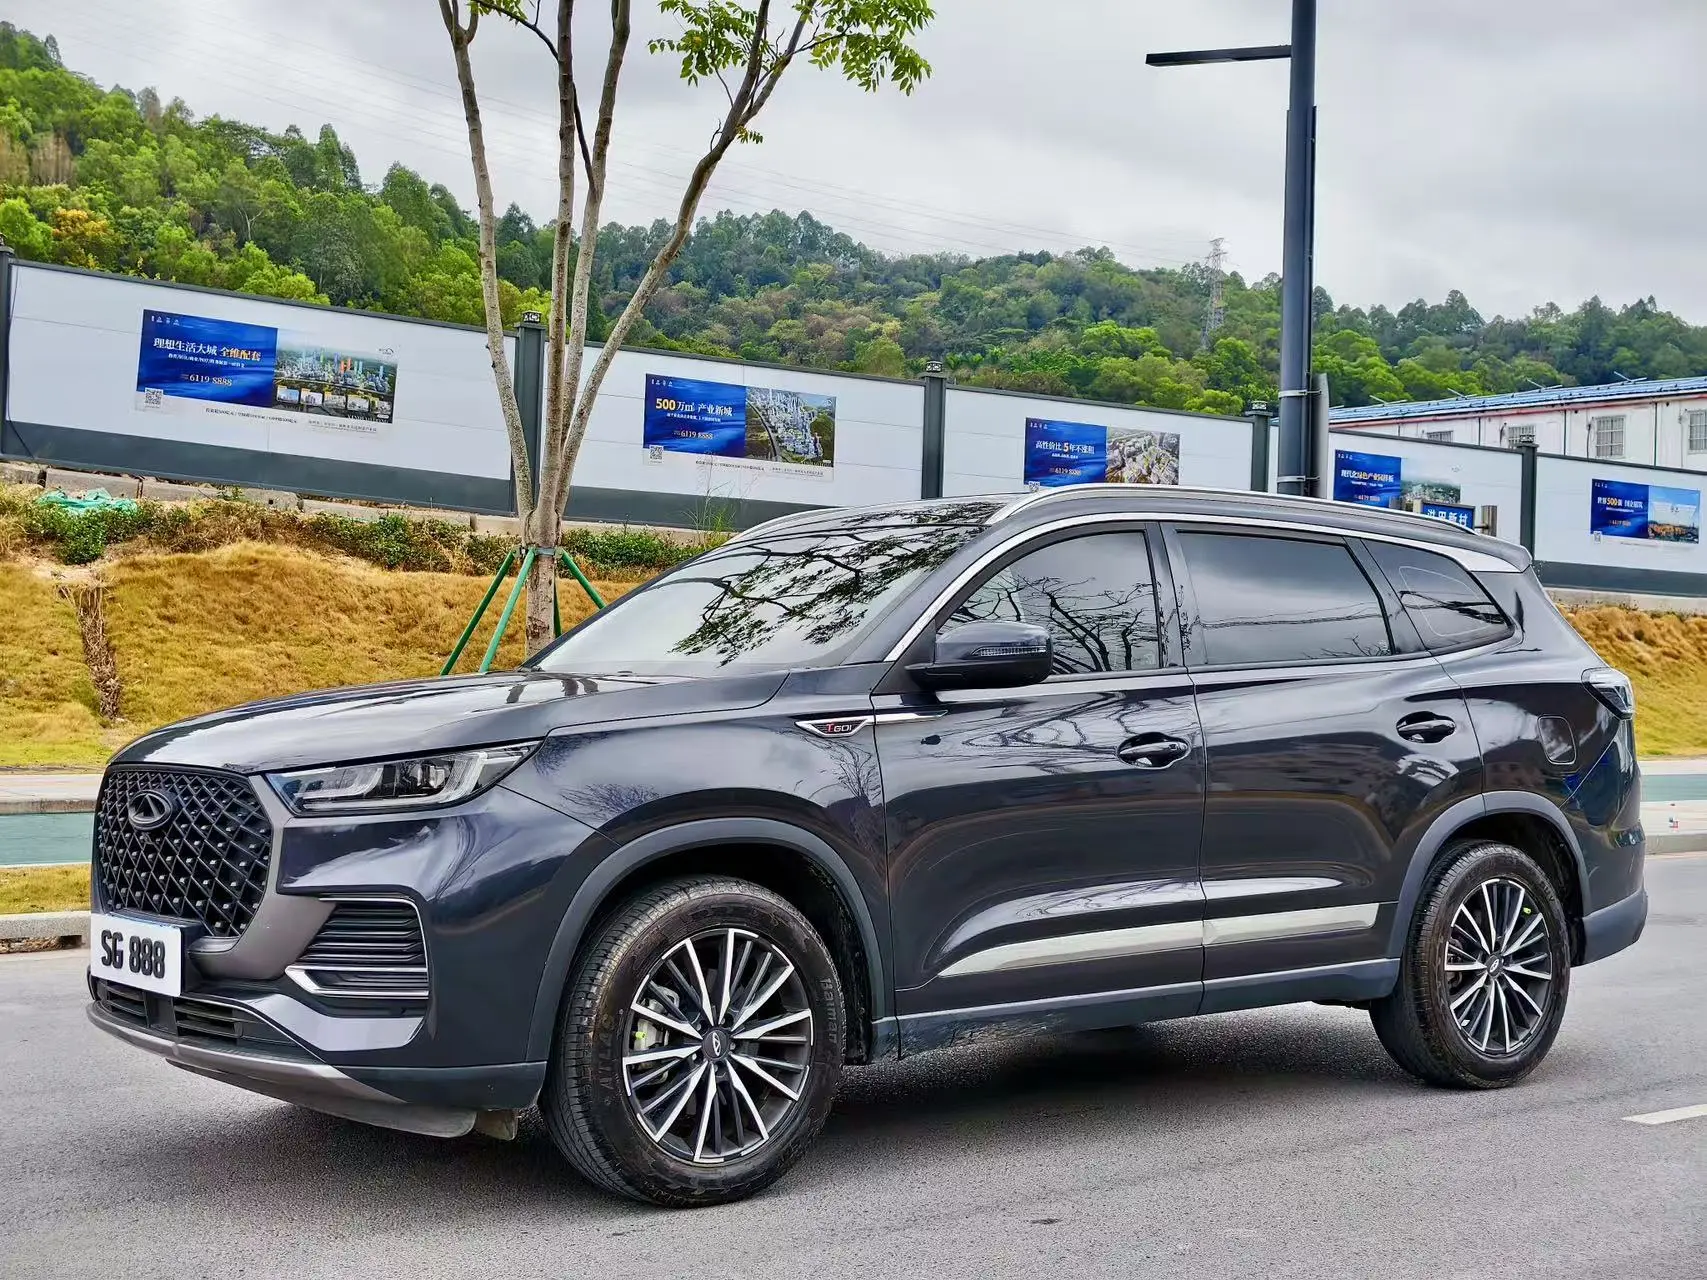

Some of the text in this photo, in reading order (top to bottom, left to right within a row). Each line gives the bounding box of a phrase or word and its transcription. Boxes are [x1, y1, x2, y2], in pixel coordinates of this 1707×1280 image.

[153, 337, 218, 356] 理想生活大城
[220, 346, 262, 362] 全维配套
[189, 374, 210, 383] 6119
[697, 403, 733, 417] 产业新城
[101, 929, 166, 979] SG 888
